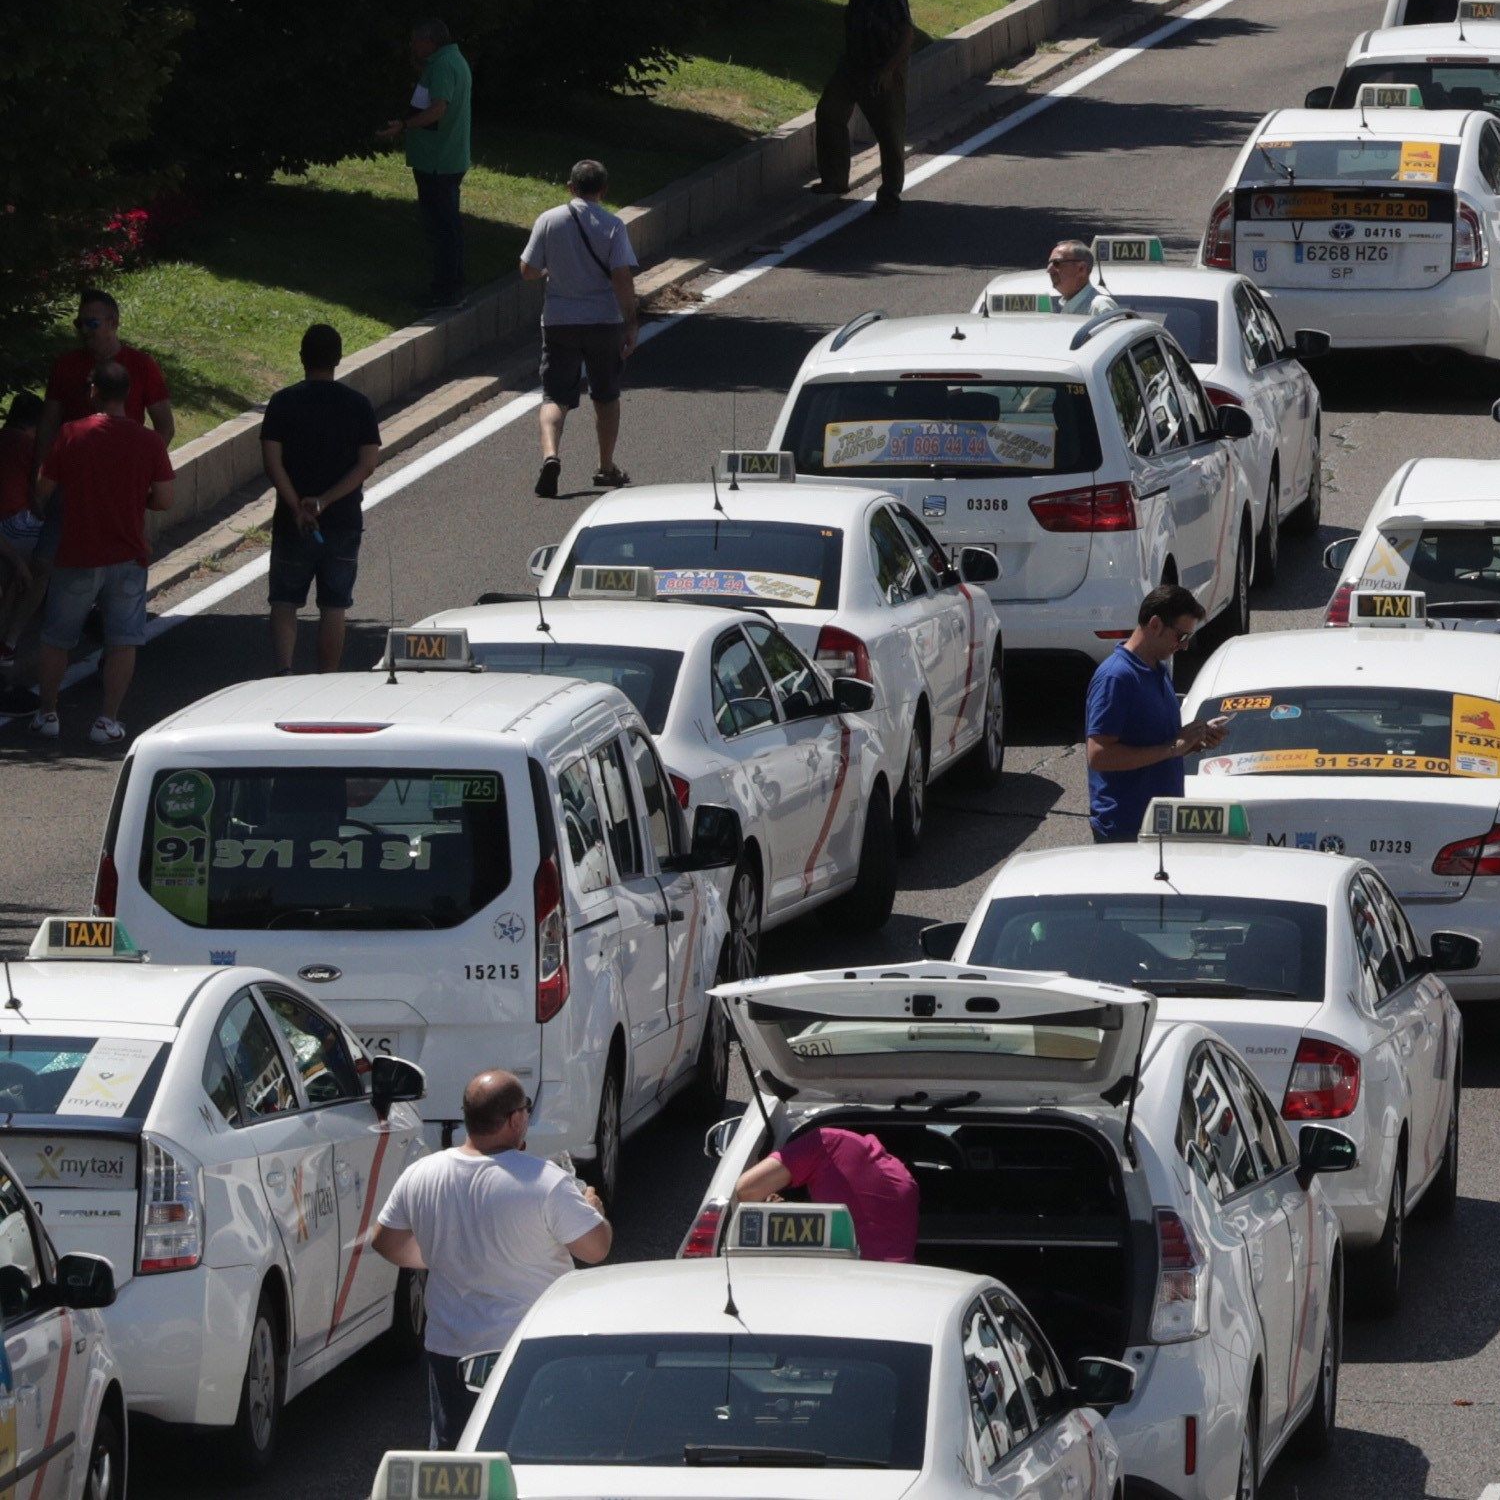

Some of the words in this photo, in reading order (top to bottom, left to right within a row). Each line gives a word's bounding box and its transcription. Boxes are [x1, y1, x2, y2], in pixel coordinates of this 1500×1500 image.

[1472, 4, 1496, 18] TAXI
[1378, 89, 1406, 105] TAXI
[1354, 203, 1380, 216] 547
[1386, 203, 1404, 216] 82
[1408, 204, 1427, 217] 00
[1364, 228, 1402, 239] 04716
[1114, 243, 1145, 258] TAXI
[1306, 246, 1350, 262] 6268
[1355, 246, 1389, 261] HZG
[1331, 267, 1354, 279] SP
[919, 423, 958, 436] TAXI
[891, 437, 907, 456] 91
[914, 437, 940, 456] 806
[944, 437, 962, 456] 44
[968, 437, 987, 456] 44
[743, 454, 778, 473] TAXI
[967, 498, 1009, 511] 03368
[1373, 596, 1411, 617] TAXI
[407, 636, 446, 659] TAXI
[1222, 696, 1272, 711] X-2229
[1455, 734, 1500, 750] Taxi
[1314, 757, 1336, 768] 91
[1347, 757, 1383, 768] 547
[1392, 758, 1417, 770] 82
[1424, 760, 1449, 772] 00
[1178, 806, 1224, 833] TAXI
[1268, 833, 1286, 847] M
[1370, 839, 1412, 854] 07329
[156, 837, 208, 866] 91
[213, 839, 293, 869] 371
[310, 840, 363, 868] 21
[380, 839, 430, 870] 31
[67, 921, 112, 947] TAXI
[464, 964, 519, 980] 15215
[68, 1097, 125, 1109] mytaxi
[60, 1156, 124, 1177] mytaxi
[770, 1214, 823, 1244] TAXI
[422, 1463, 481, 1498] TAXI
